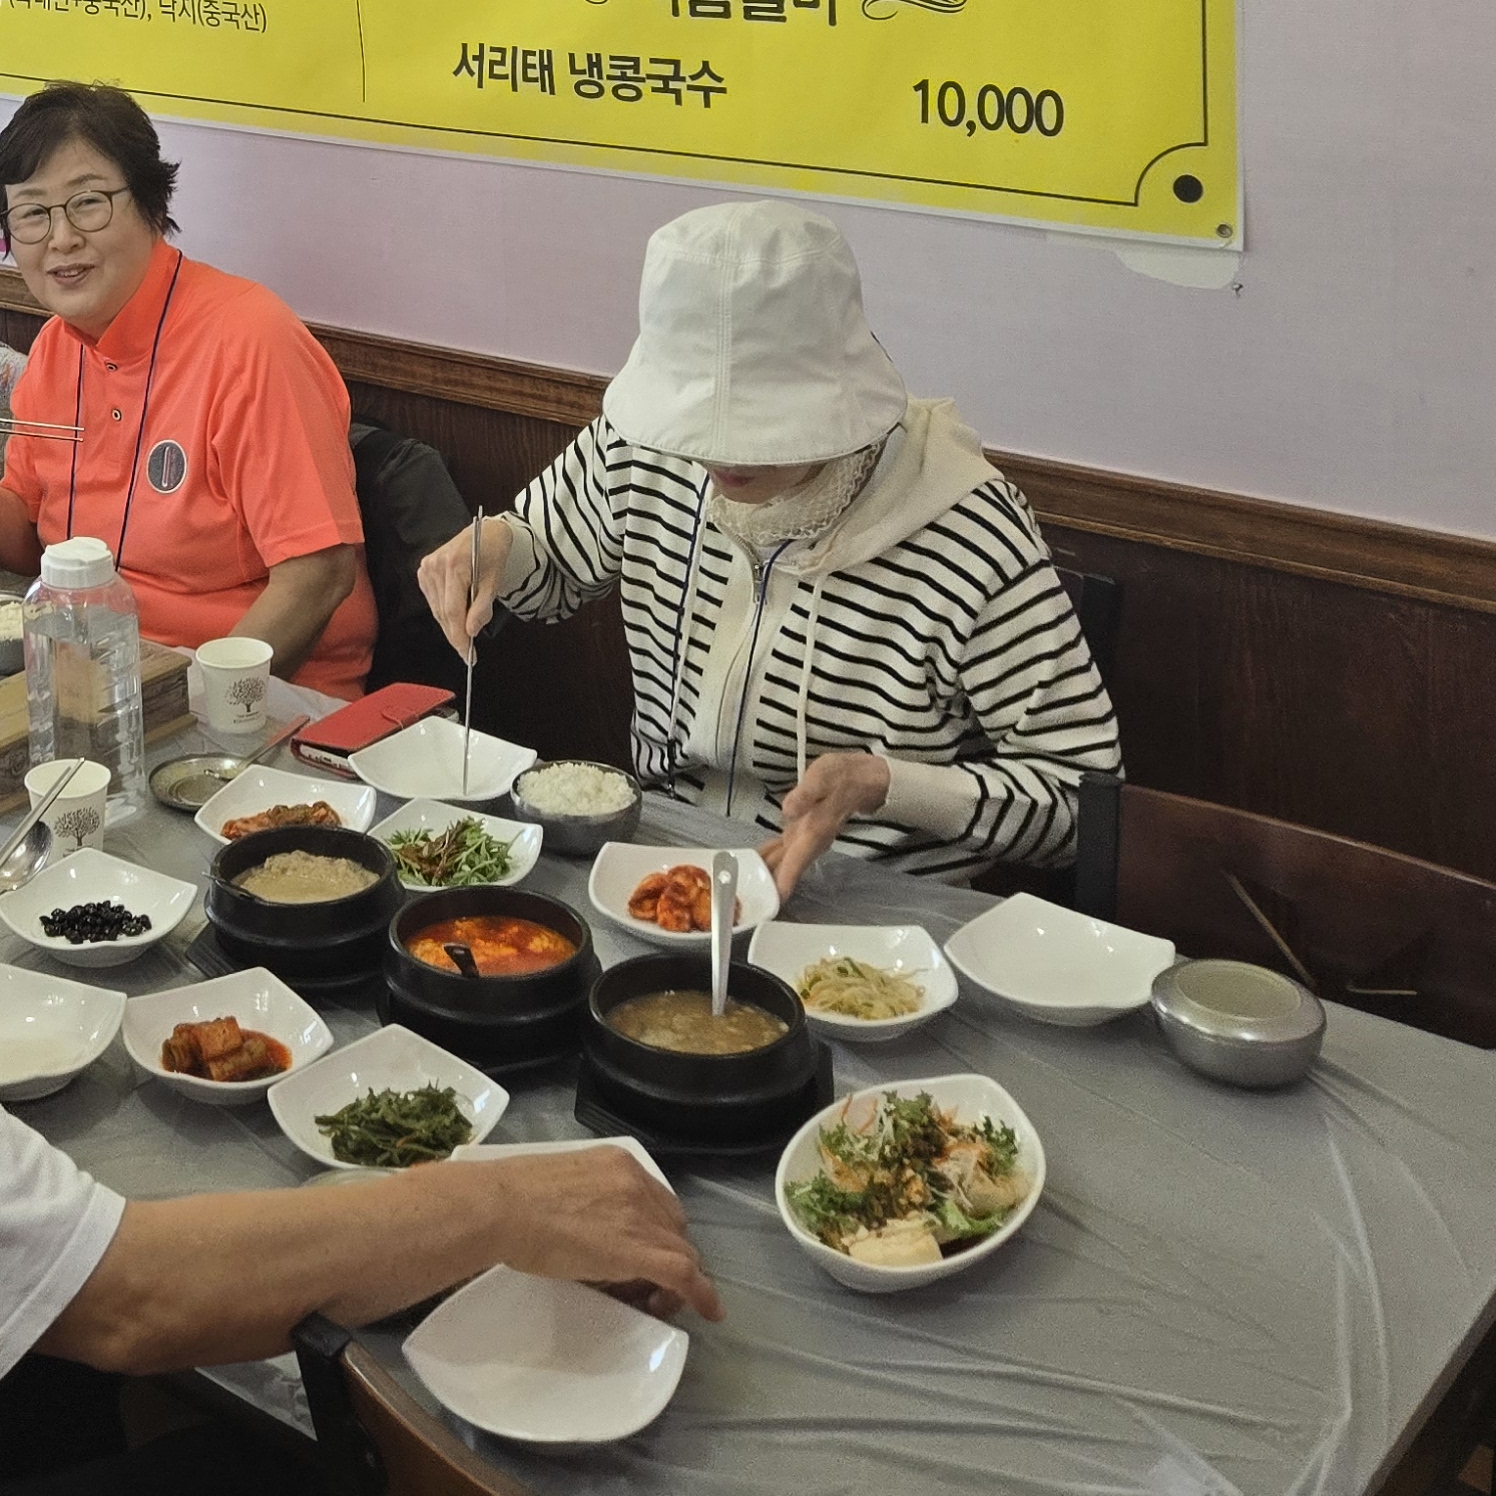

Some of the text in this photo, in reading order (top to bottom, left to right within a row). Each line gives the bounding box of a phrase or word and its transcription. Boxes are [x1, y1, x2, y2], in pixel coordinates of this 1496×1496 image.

[452, 42, 1066, 140] 서리태 냉콩국수 10,000
